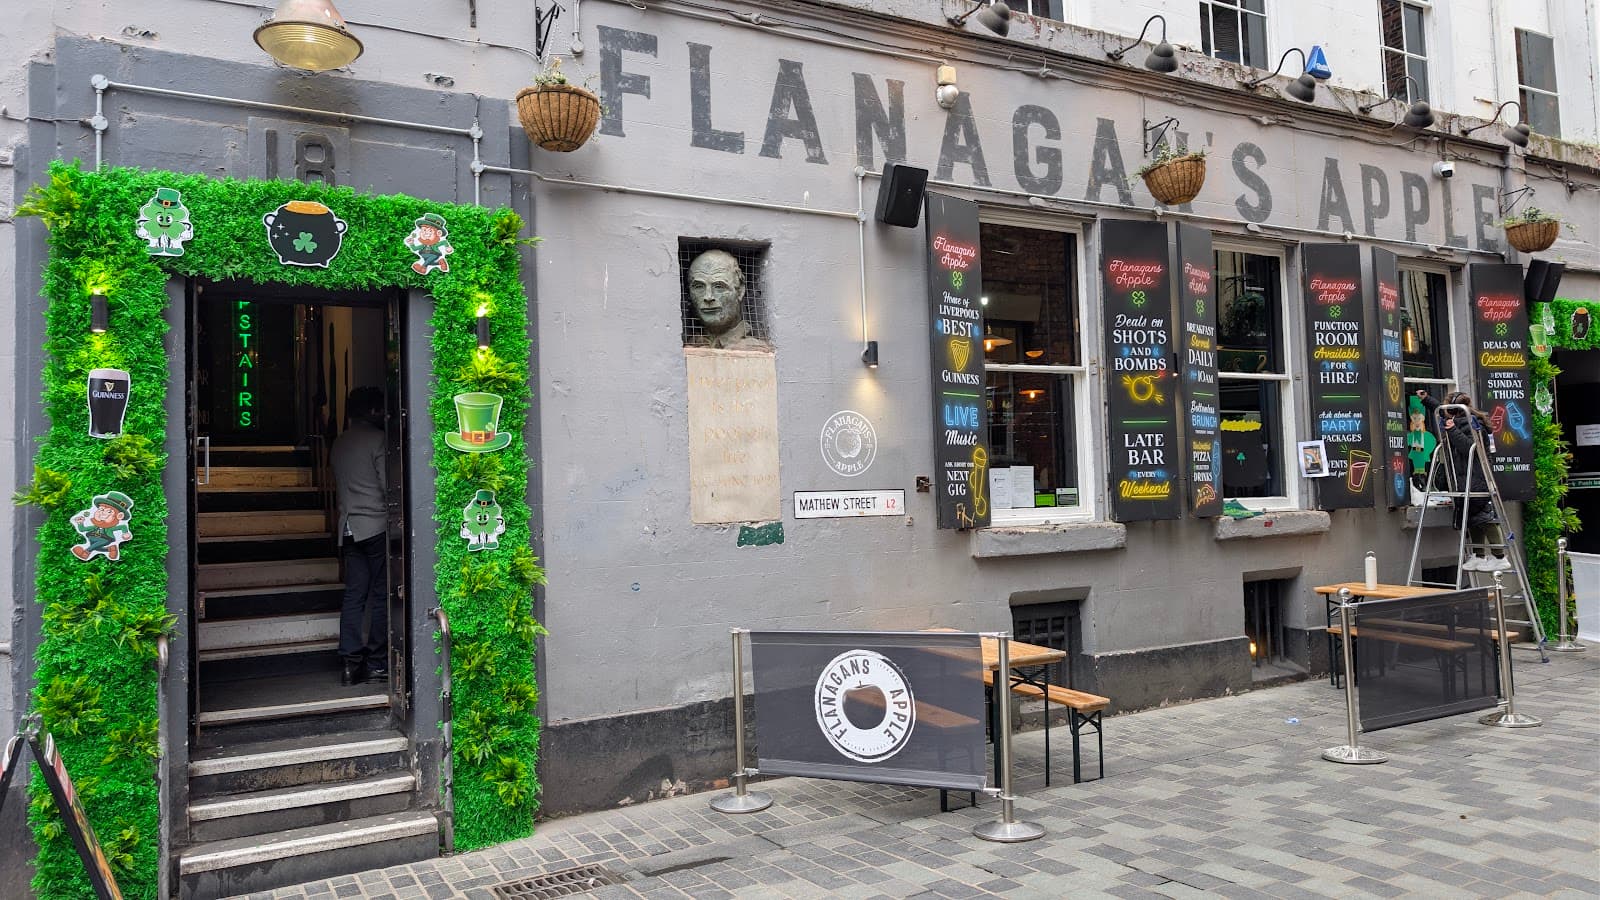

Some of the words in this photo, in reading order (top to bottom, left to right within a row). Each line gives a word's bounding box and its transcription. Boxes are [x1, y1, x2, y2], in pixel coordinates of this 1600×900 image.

[1317, 157, 1499, 250] APPLE
[941, 253, 968, 269] Apple
[1116, 272, 1155, 288] Apple
[942, 290, 961, 305] Home
[962, 298, 971, 308] of
[1318, 290, 1346, 304] Apple
[1115, 313, 1147, 328] Deals
[1151, 318, 1164, 328] on
[1483, 308, 1513, 321] Apple
[942, 318, 973, 338] BEST
[1186, 321, 1215, 337] BREAKFAST
[1314, 321, 1359, 331] FUNCTION
[1113, 330, 1167, 345] SHOTS
[1315, 332, 1359, 346] ROOM
[1483, 341, 1508, 349] DEALS
[1511, 340, 1522, 349] ON
[1130, 347, 1152, 356] AND
[1188, 348, 1214, 368] DAILY
[1313, 346, 1361, 359] Available
[1114, 358, 1167, 371] BOMBS
[1330, 362, 1348, 370] FOR
[1383, 359, 1401, 373] SPORT
[1481, 351, 1526, 367] Cocktails
[942, 369, 980, 386] GUINNESS
[1197, 370, 1214, 384] 10AM
[1320, 371, 1359, 384] HIRE!
[1487, 380, 1524, 388] SUNDAY
[92, 390, 126, 400] GUINNESS
[1493, 390, 1525, 399] THURS
[944, 404, 979, 427] LIVE
[1191, 414, 1217, 428] BRUNCH
[1318, 410, 1333, 419] Ask
[1333, 410, 1352, 419] about
[825, 415, 872, 440] FLANAGANS
[1321, 420, 1361, 431] PARTY
[945, 429, 978, 447] Music
[1124, 433, 1165, 448] LATE
[1321, 434, 1362, 442] PACKAGES
[1128, 449, 1165, 465] BAR
[1193, 451, 1211, 462] PIZZA
[835, 460, 864, 473] APPLE
[1513, 464, 1530, 472] MORE
[946, 470, 970, 481] NEXT
[1193, 472, 1213, 482] DRINKS
[948, 484, 966, 496] GIG
[1120, 480, 1170, 498] Weekend
[799, 498, 840, 511] MATHEW
[843, 496, 878, 510] STREET
[886, 498, 897, 509] L2
[822, 659, 870, 740] FLANAGANS
[884, 688, 908, 743] APPLE
